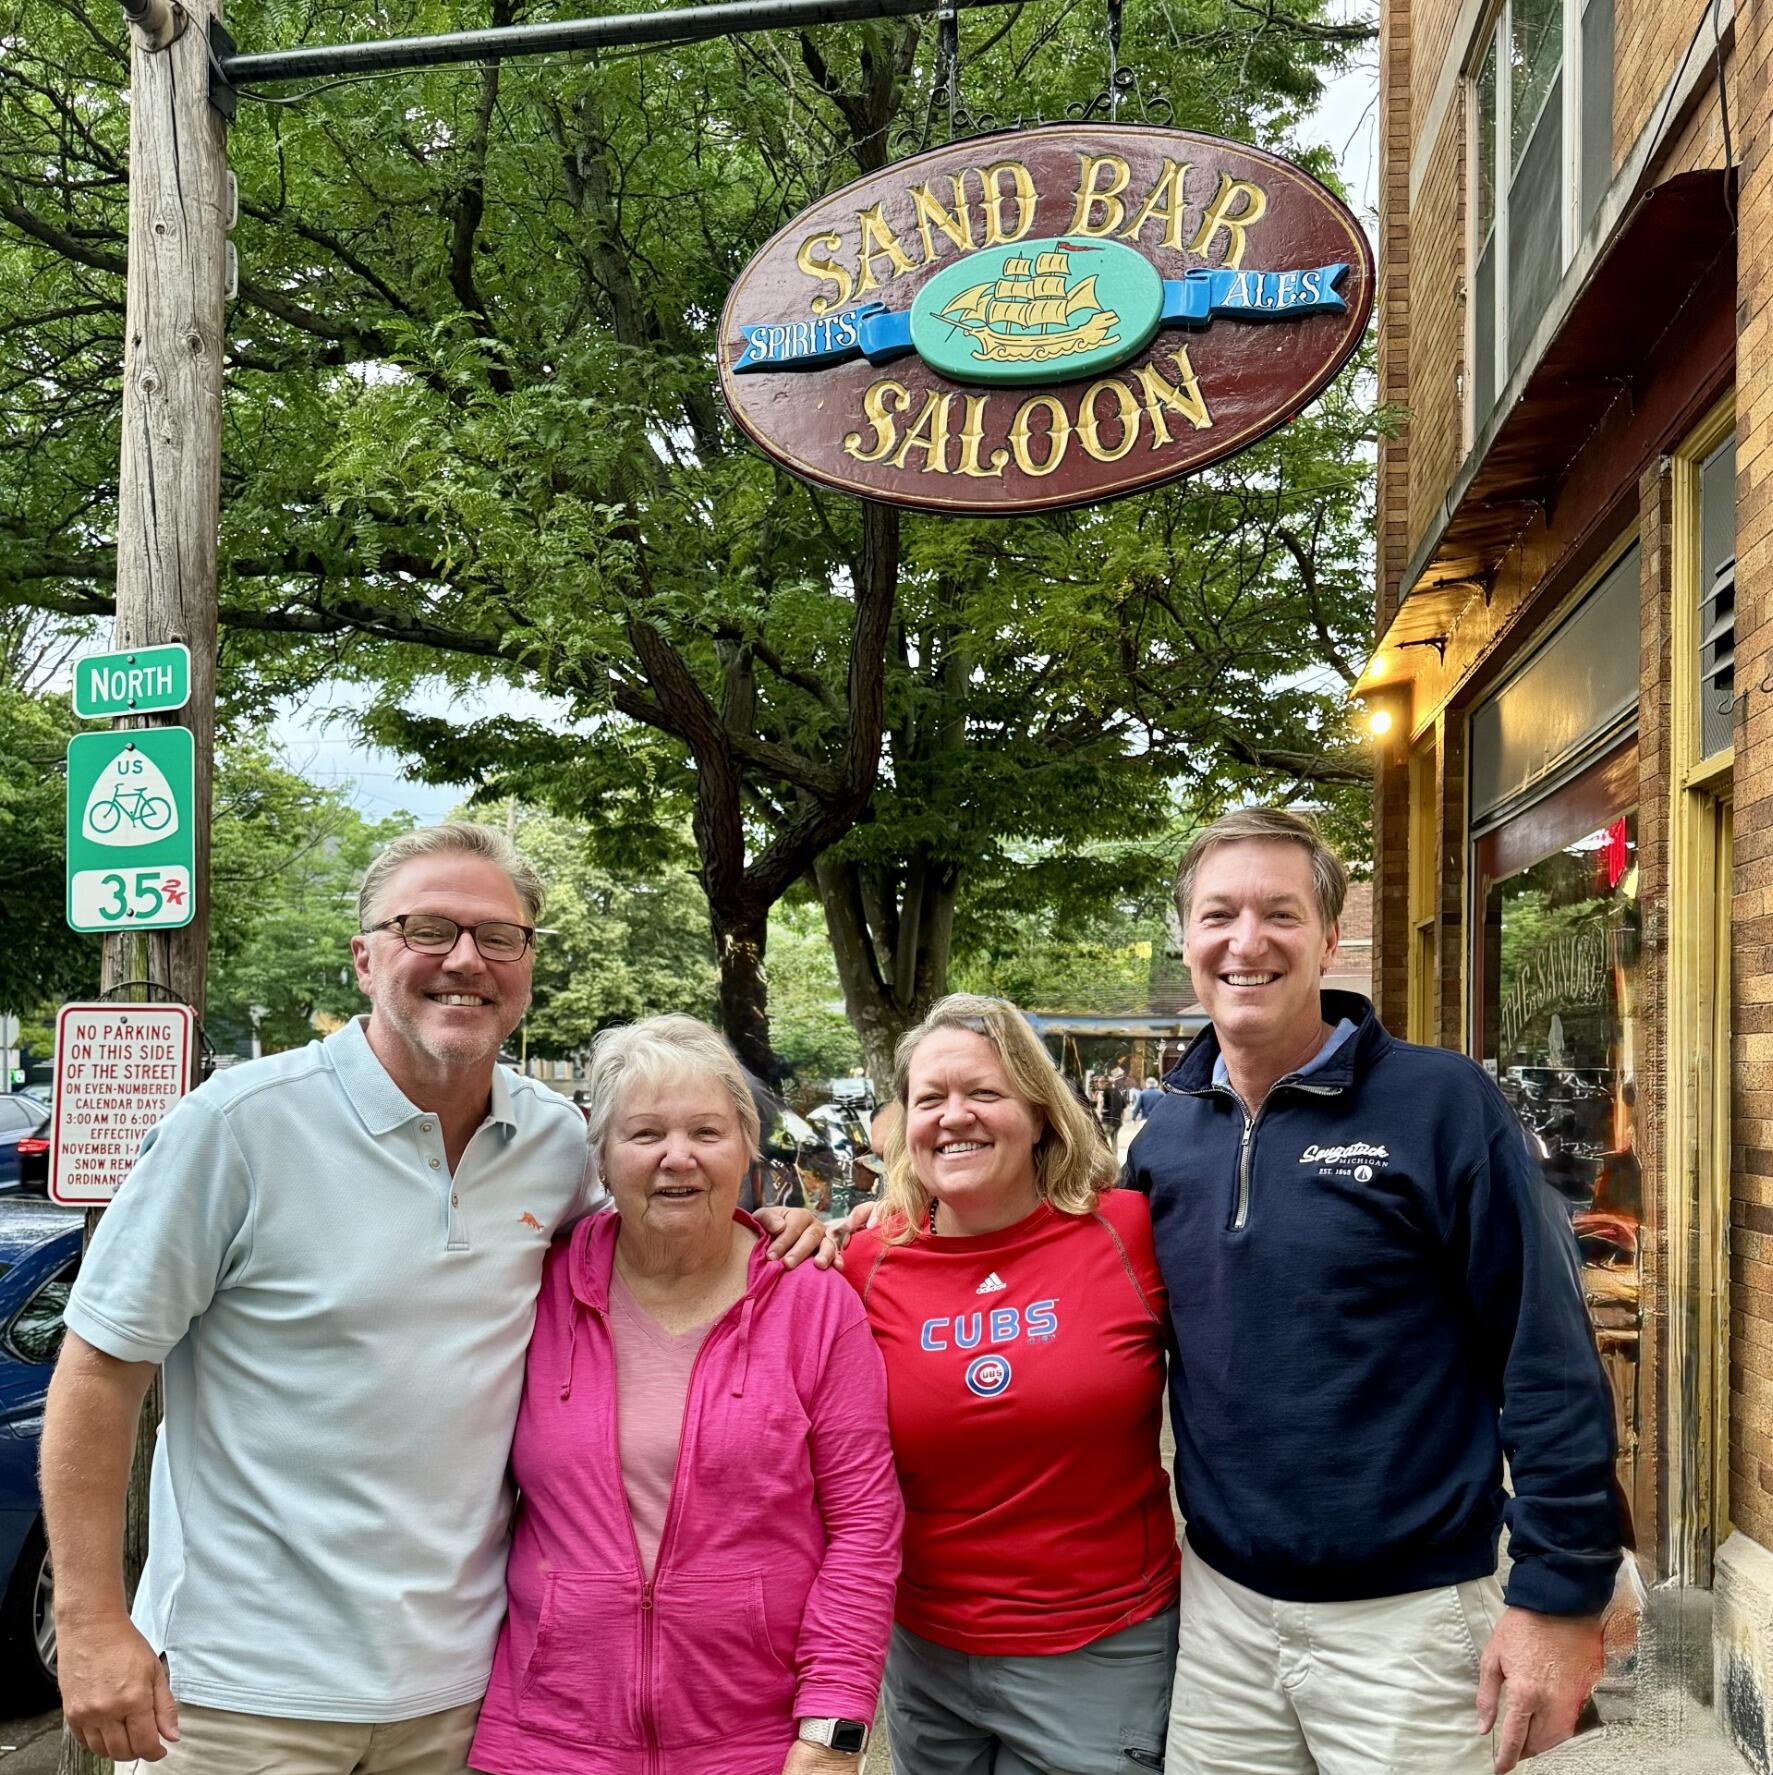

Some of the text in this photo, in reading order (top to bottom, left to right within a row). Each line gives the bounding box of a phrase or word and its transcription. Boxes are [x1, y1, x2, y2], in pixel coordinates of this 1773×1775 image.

[797, 151, 1269, 315] SAND BAR
[1220, 271, 1322, 310] ALES
[748, 311, 859, 362] SPIRITS
[843, 343, 1214, 478] SALOON
[89, 664, 173, 703] NORTH
[117, 760, 144, 775] US
[98, 872, 162, 921] 35
[76, 1025, 171, 1041] NO PARKING
[71, 1045, 175, 1060] ON THIS SIDE
[67, 1064, 177, 1080] OF THE STREET
[66, 1083, 176, 1095] ON EVEN-NUMBERED
[75, 1098, 166, 1110] CALENDAR DAYS
[113, 1113, 126, 1125] TO
[62, 1143, 121, 1155] NOVEMBER
[74, 1158, 105, 1170] SNOW
[1339, 1157, 1389, 1167] MICHIGAN
[921, 1299, 1060, 1351] CUBS
